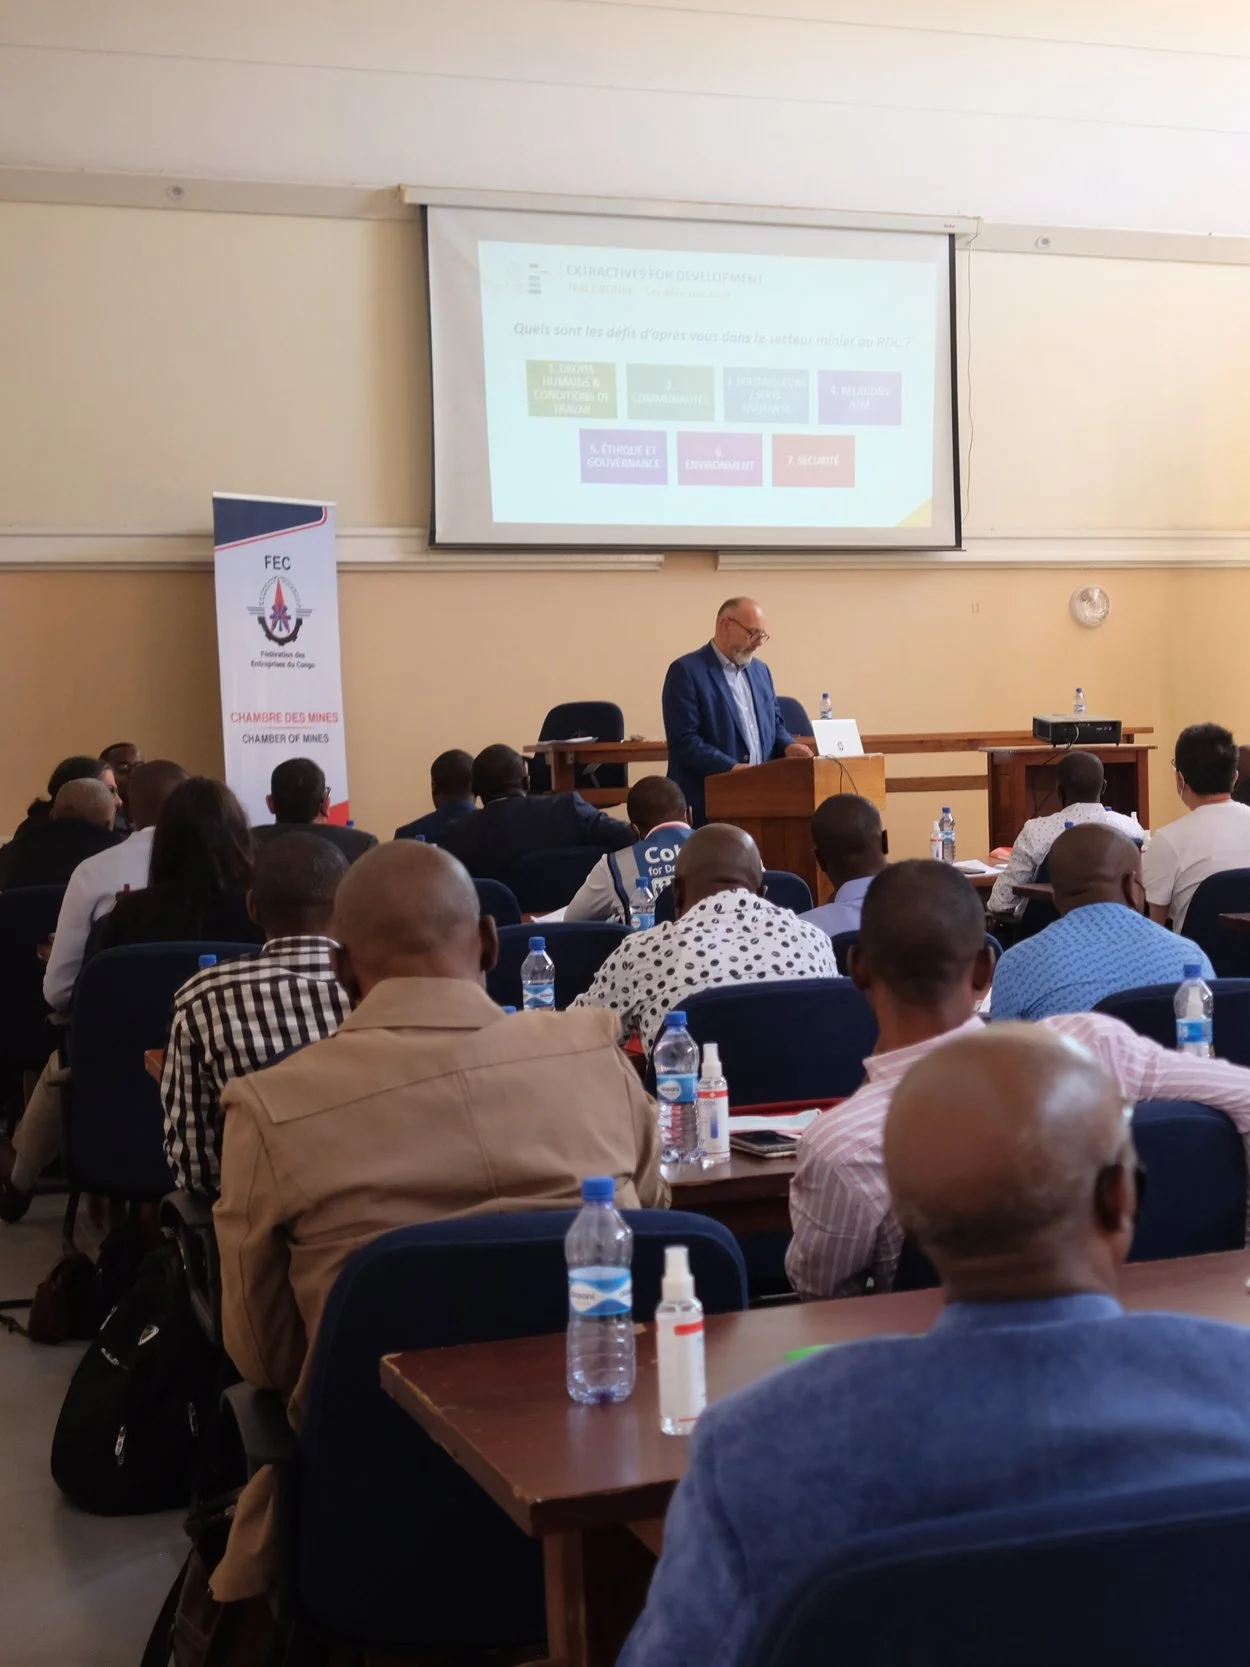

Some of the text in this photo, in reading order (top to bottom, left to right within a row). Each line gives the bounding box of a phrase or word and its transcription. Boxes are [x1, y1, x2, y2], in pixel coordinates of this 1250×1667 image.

[566, 264, 763, 286] EXTRACTIVES FOR DEVELOPMENT
[513, 322, 550, 336] Quels
[553, 325, 582, 337] sont
[586, 325, 603, 338] les
[606, 325, 636, 341] défis
[689, 331, 718, 343] vous
[721, 330, 750, 344] dans
[754, 330, 766, 345] le
[768, 333, 812, 346] secteur
[876, 337, 901, 349] RDC
[905, 337, 913, 349] ?
[558, 363, 595, 375] DROITS
[542, 376, 591, 388] HUMAINS
[533, 389, 595, 402] CONDITIONS
[587, 456, 661, 470] GOUVERNANCE
[786, 454, 796, 465] 7.
[264, 554, 291, 571] FEC
[260, 650, 305, 659] Fédération des
[250, 659, 316, 670] Entreprises du Congo
[230, 711, 339, 724] CHAMBRE DES MINES
[242, 733, 330, 744] CHAMBER OF MINES
[648, 865, 662, 877] for
